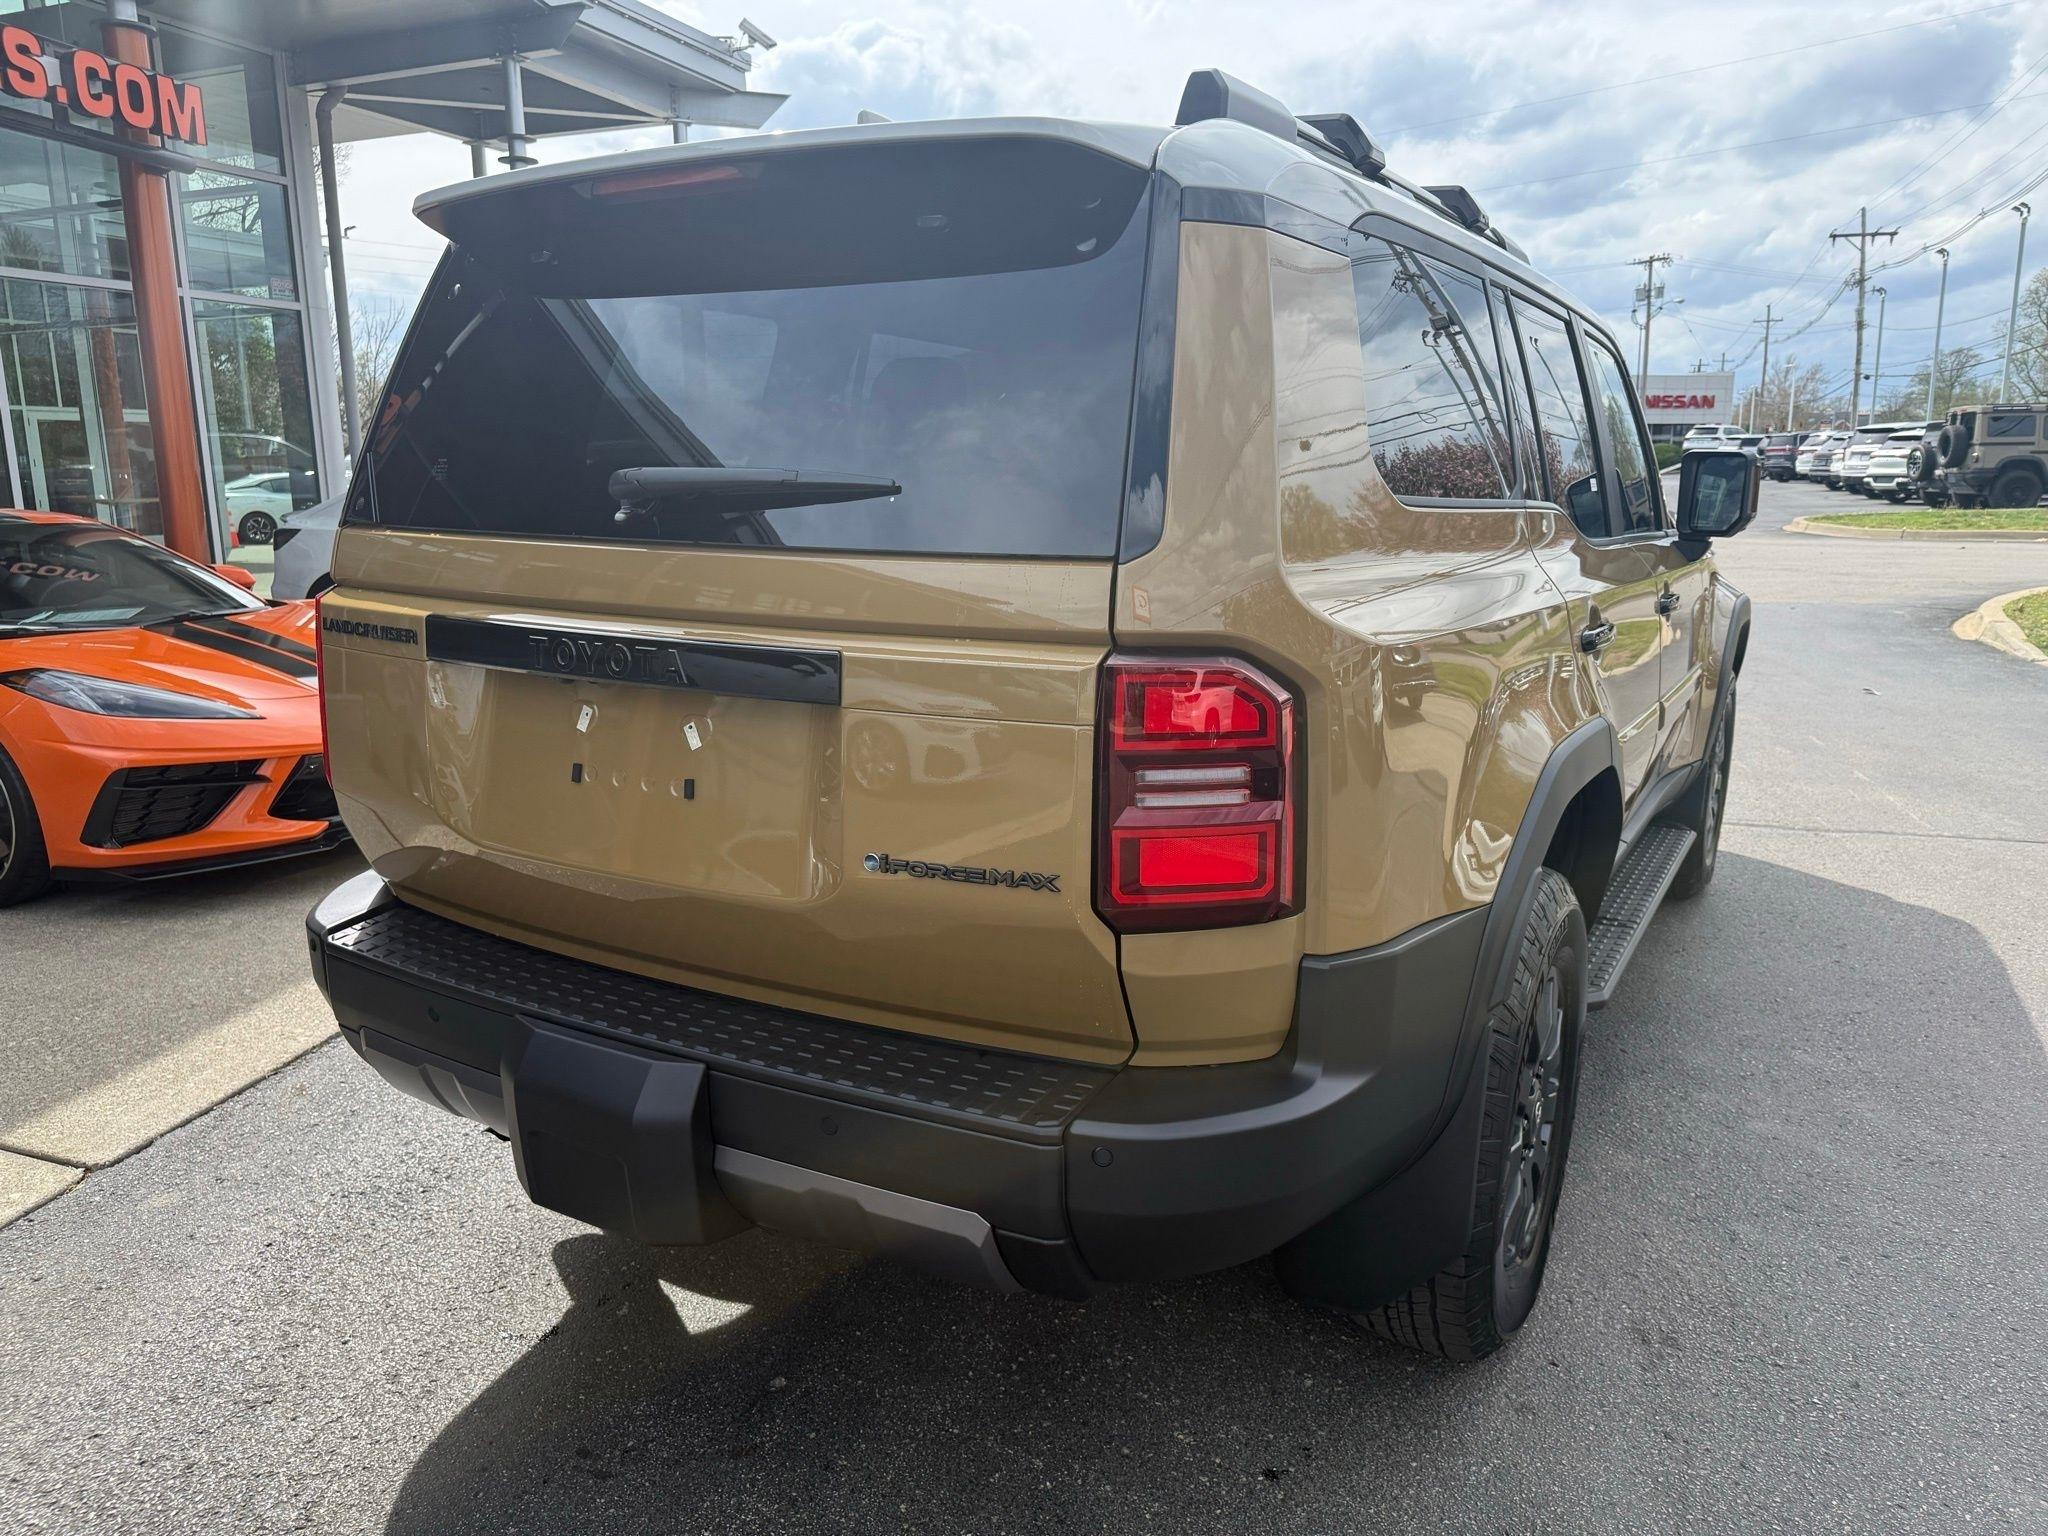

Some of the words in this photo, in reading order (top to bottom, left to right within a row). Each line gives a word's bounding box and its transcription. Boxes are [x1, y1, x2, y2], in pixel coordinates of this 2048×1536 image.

[0, 25, 208, 146] S.COM
[1645, 394, 1716, 409] NISSAN
[528, 635, 688, 684] TOYOTA
[988, 867, 1061, 893] MAX
